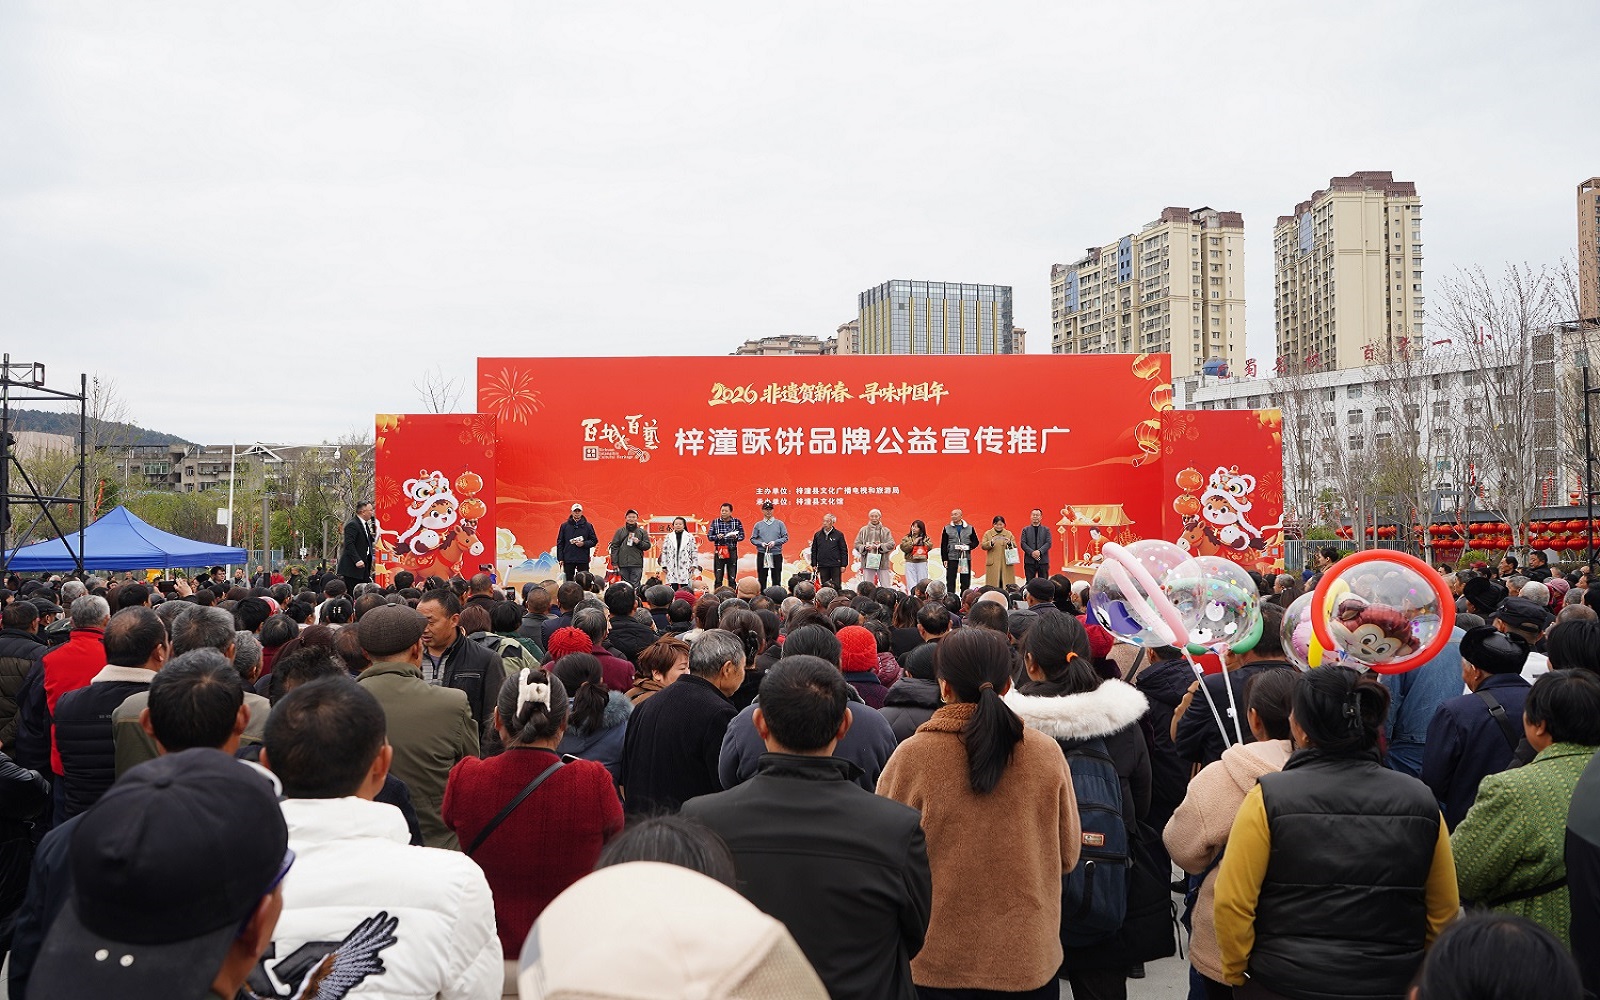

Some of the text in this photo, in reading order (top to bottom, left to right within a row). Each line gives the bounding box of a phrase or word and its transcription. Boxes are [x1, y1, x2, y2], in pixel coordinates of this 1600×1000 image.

[859, 381, 949, 406] 寻味中国年
[674, 426, 1071, 456] 梓潼酥饼品牌公益宣传推广
